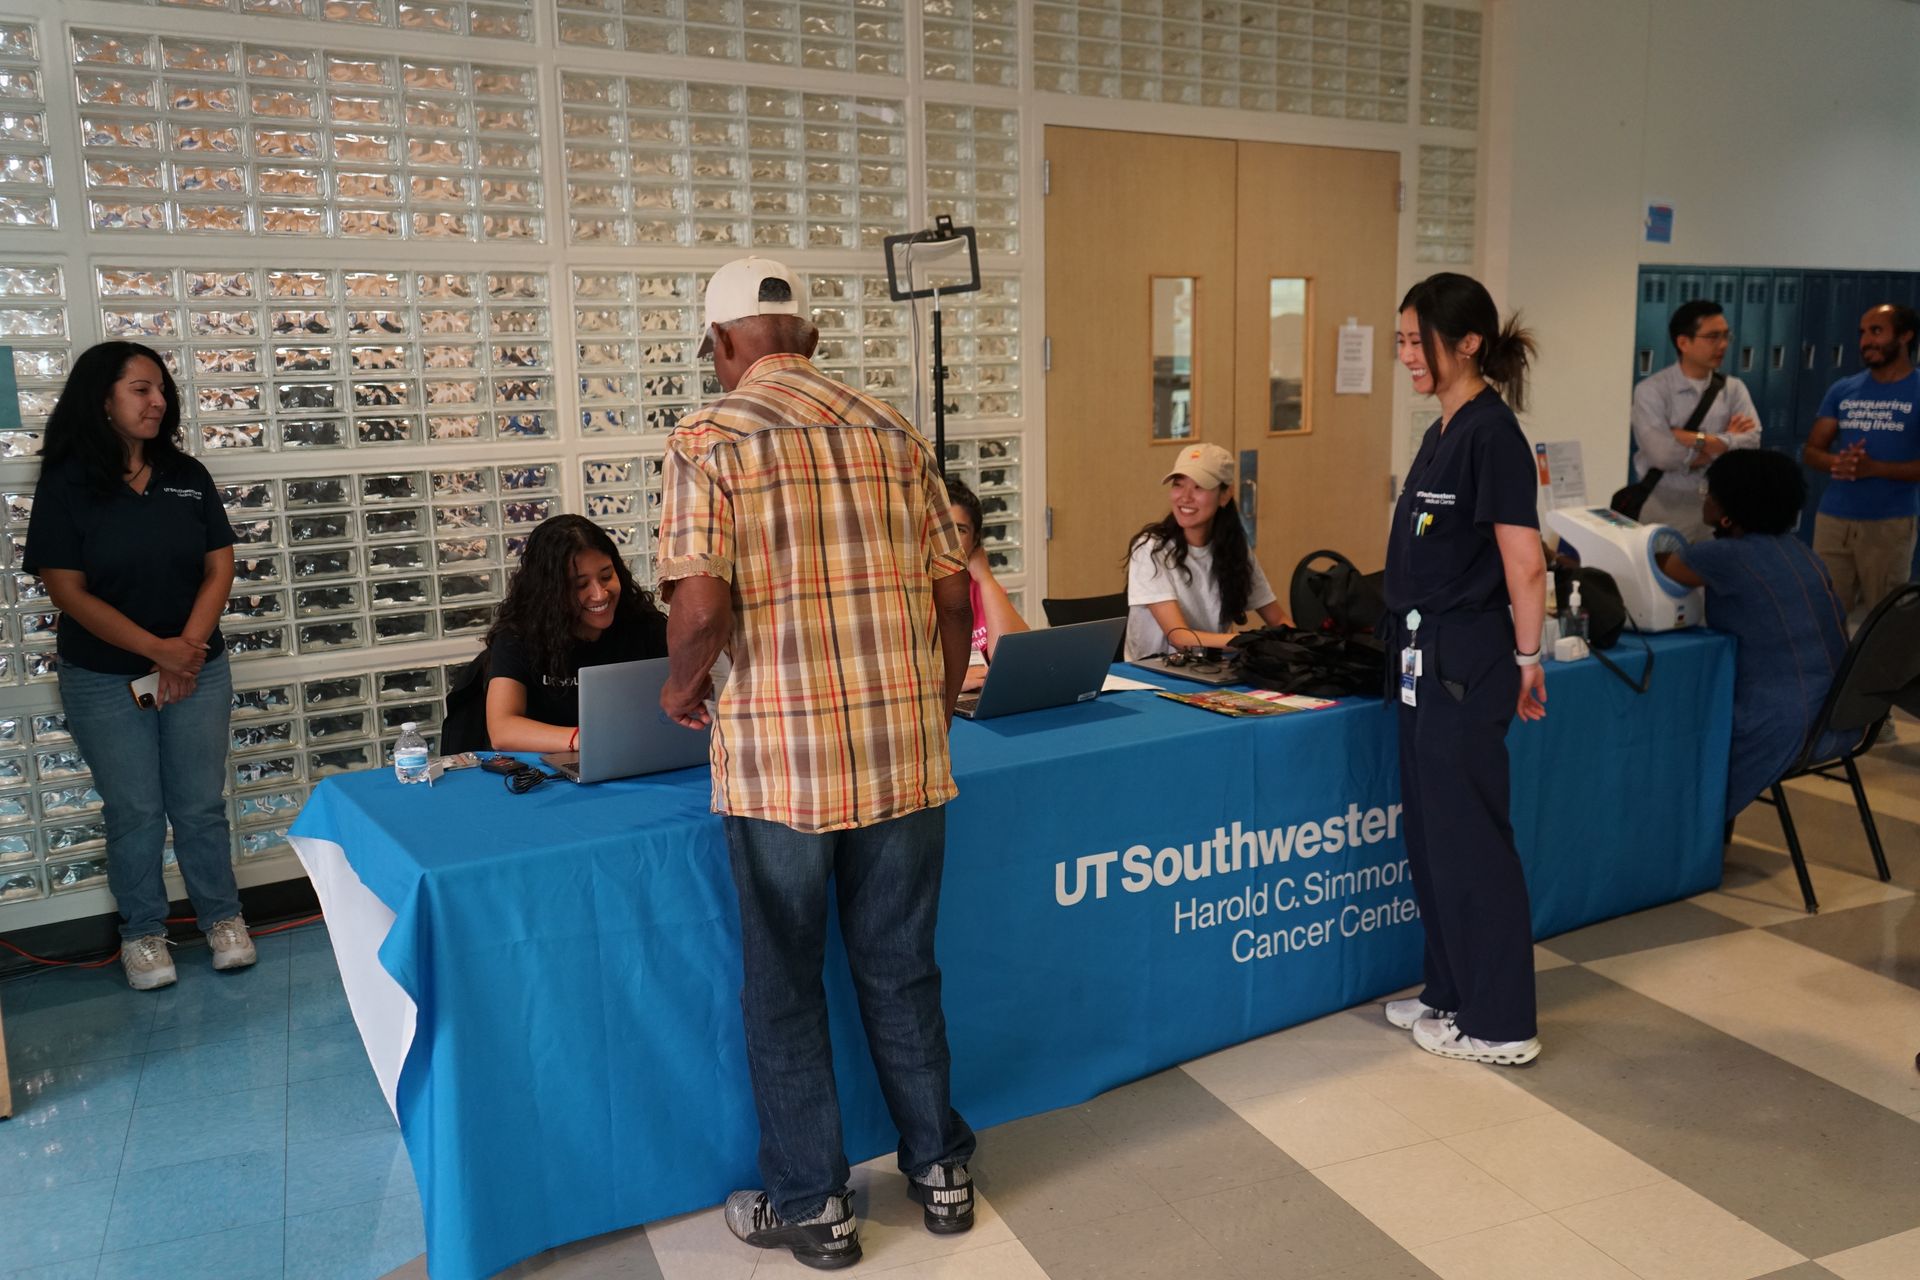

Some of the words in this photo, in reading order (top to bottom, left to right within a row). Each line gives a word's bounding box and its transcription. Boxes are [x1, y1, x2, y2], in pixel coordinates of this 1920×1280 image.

[1120, 802, 1403, 894] Southwester
[1174, 881, 1269, 934] Harold
[1275, 879, 1301, 911] C.
[1304, 858, 1413, 906] Simmon
[1231, 917, 1335, 964] Cancer
[932, 1187, 969, 1205] PUMA
